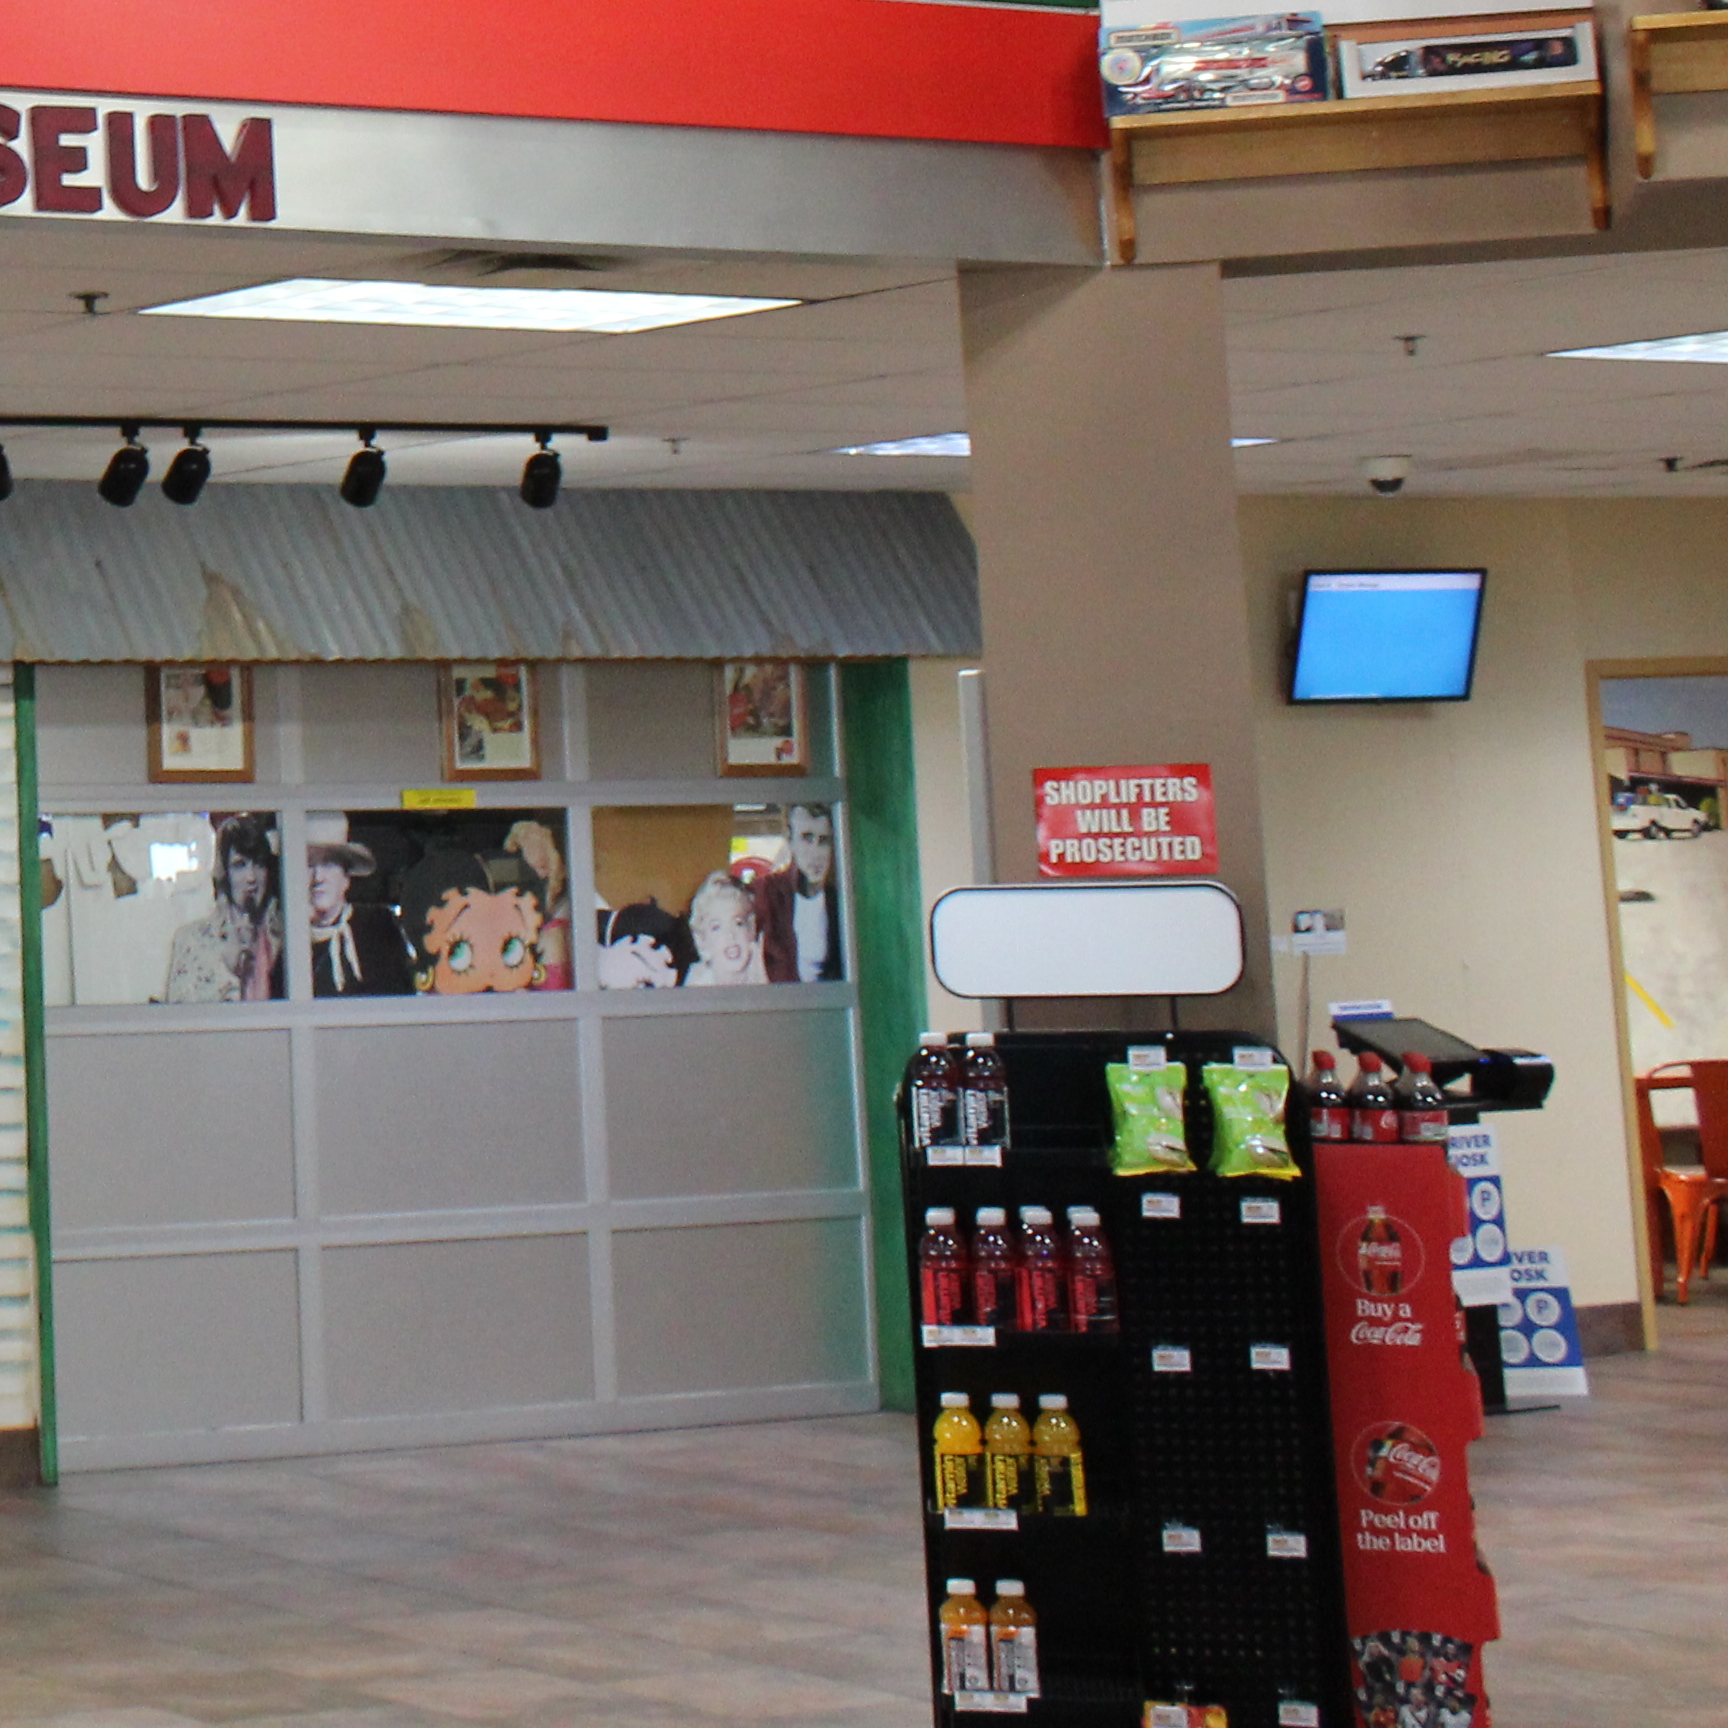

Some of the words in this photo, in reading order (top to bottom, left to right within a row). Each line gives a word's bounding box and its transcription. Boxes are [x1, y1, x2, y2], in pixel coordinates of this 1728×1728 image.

[1044, 776, 1199, 805] SHOPLIFTERS
[1075, 808, 1134, 834] WILL
[1141, 806, 1172, 832] BE
[1049, 835, 1203, 863] PROSECUTED
[1355, 1298, 1395, 1321] Buy
[1399, 1302, 1412, 1318] a
[1359, 1508, 1406, 1530] Peel
[1409, 1510, 1441, 1531] off
[1355, 1531, 1391, 1551] the
[1394, 1532, 1447, 1554] label
